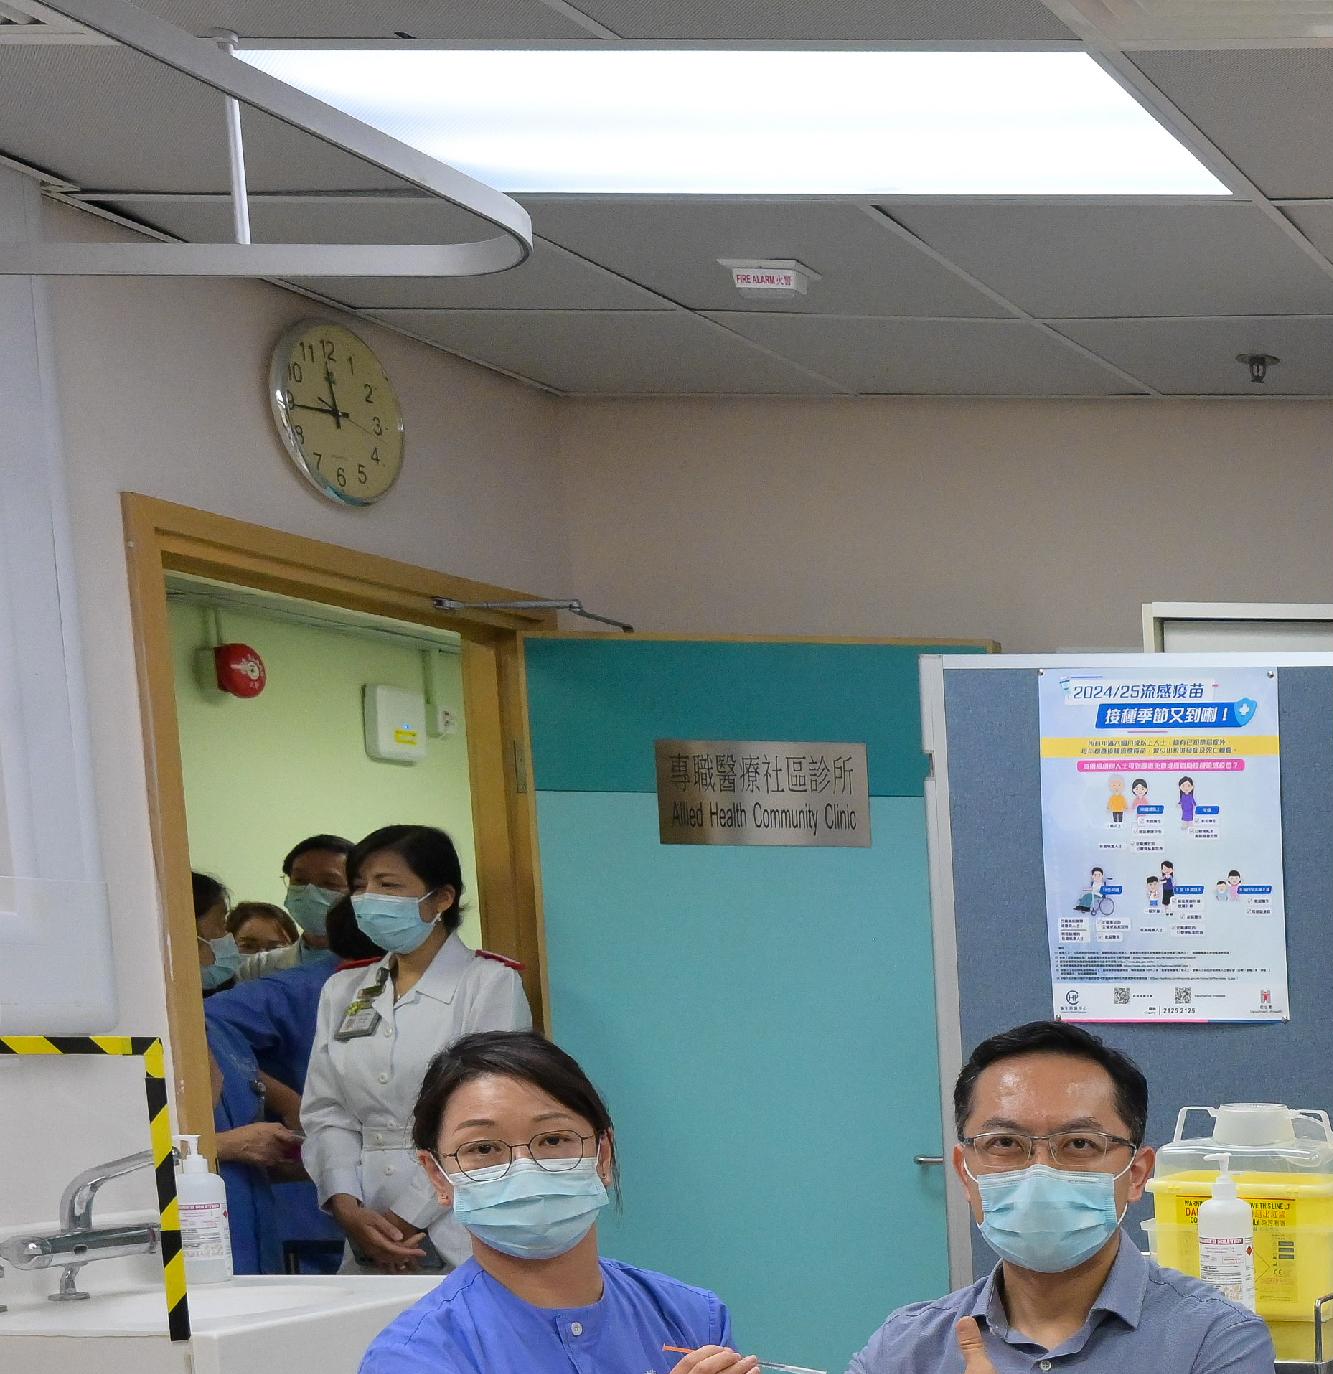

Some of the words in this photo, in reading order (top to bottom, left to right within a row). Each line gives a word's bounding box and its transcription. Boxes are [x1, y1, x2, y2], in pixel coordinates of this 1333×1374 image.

[736, 274, 751, 283] FIRE
[752, 275, 775, 284] ALARM
[299, 341, 315, 363] 11
[319, 338, 336, 363] 12
[287, 361, 302, 383] 10
[346, 356, 355, 376] 1
[364, 384, 374, 404] 2
[372, 416, 383, 437] 3
[313, 451, 322, 471] 7
[370, 447, 380, 464] 4
[336, 467, 347, 488] 6
[357, 464, 368, 485] 5
[1073, 683, 1204, 699] 2024/25流感疫苗
[669, 752, 854, 795] 專職醫療社區診所
[710, 802, 747, 829] Health
[753, 802, 818, 836] Community
[824, 803, 857, 831] Clinic
